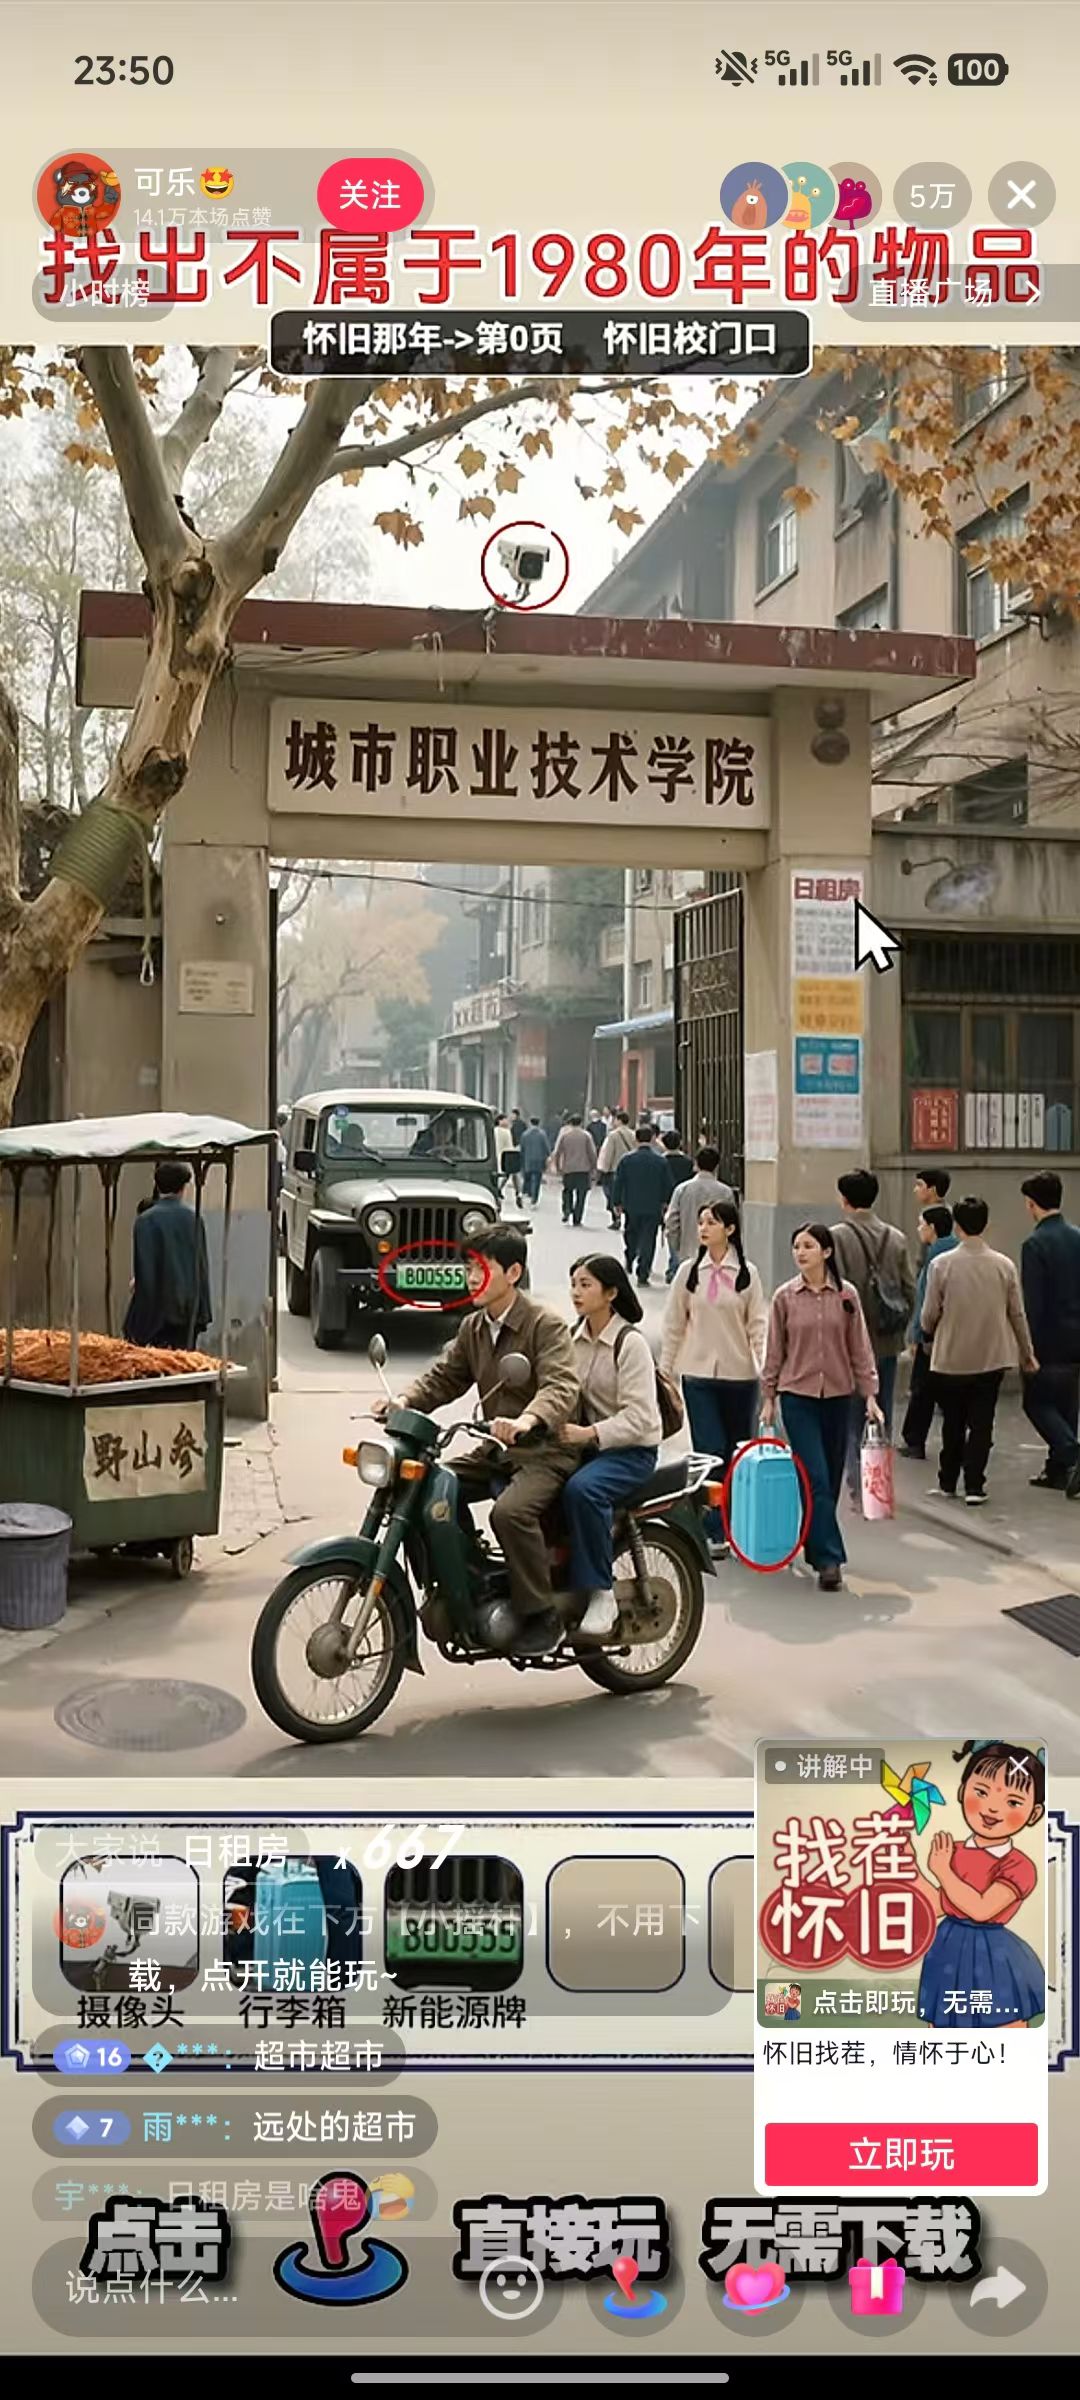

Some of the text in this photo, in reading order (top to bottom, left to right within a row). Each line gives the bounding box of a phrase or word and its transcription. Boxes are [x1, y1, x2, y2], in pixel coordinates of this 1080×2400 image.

[284, 719, 756, 807] 城市职业技术学院
